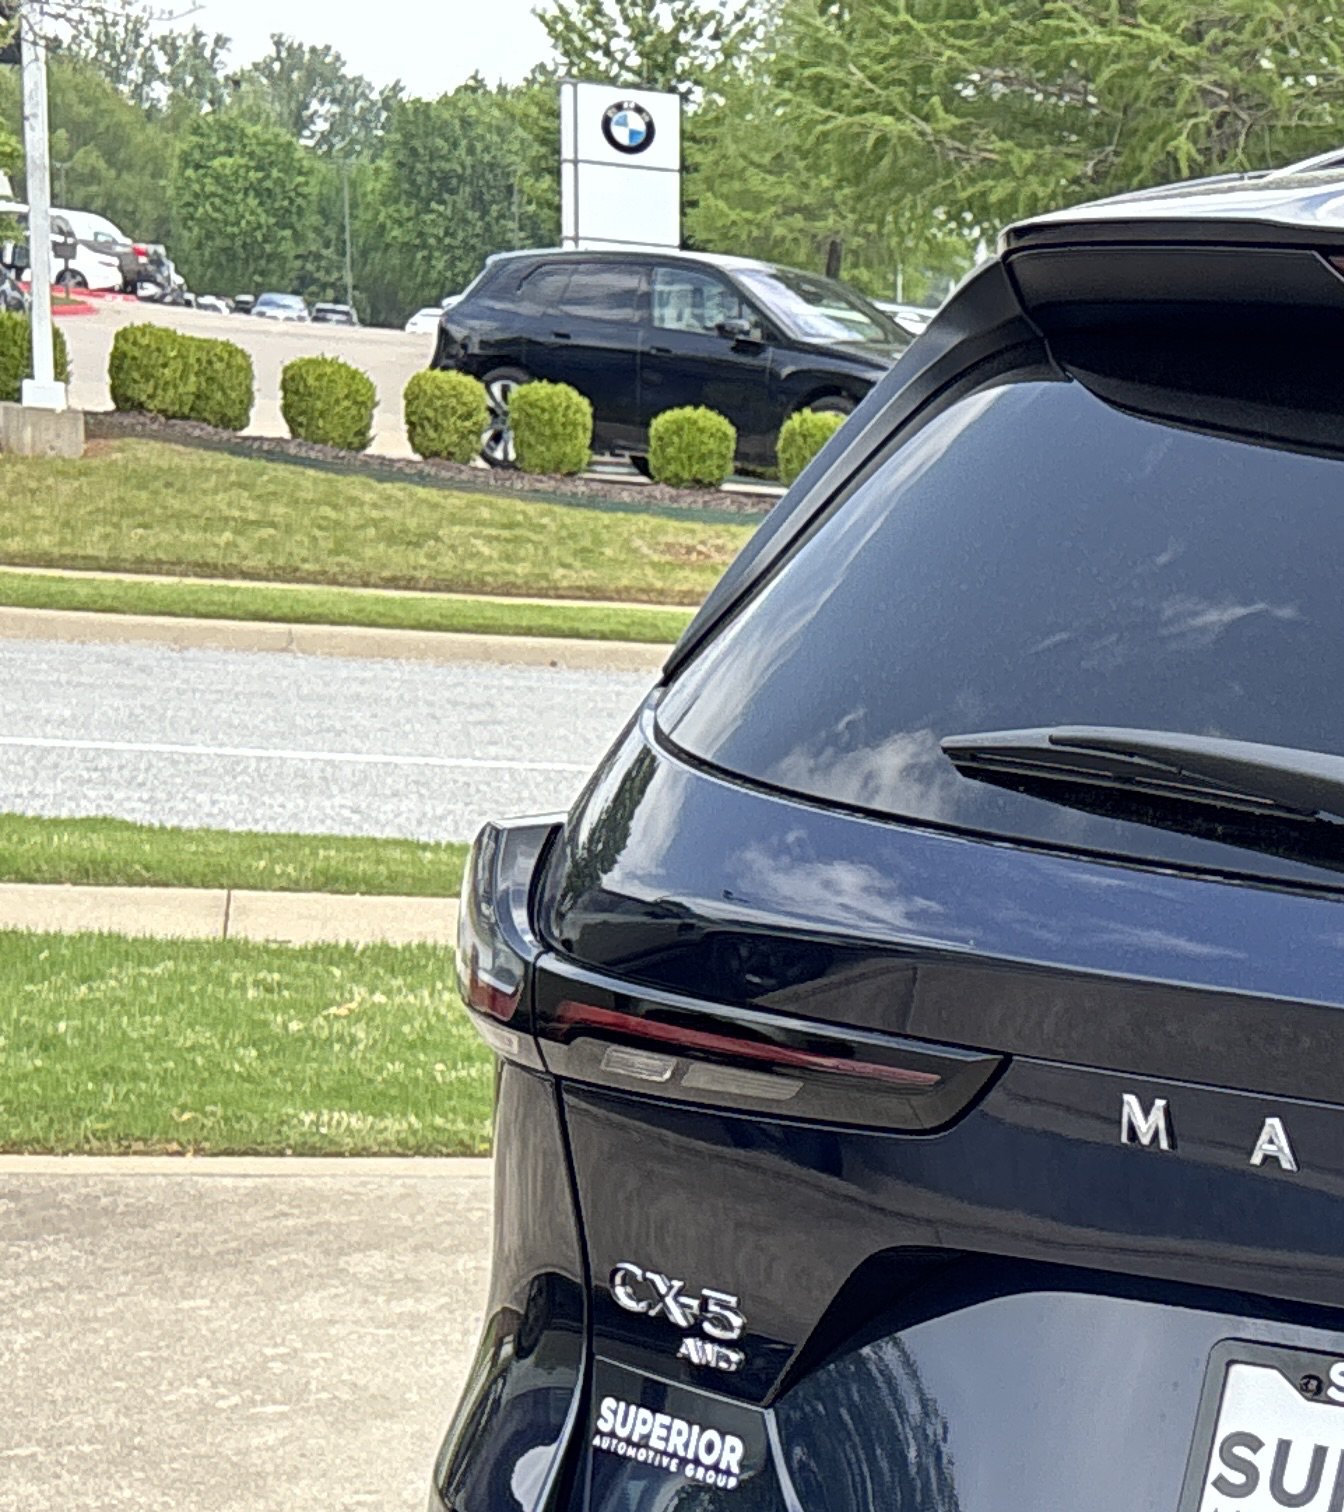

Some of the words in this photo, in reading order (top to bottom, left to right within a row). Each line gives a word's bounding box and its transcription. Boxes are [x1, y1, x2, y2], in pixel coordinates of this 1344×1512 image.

[609, 1261, 747, 1340] CX-5
[592, 1434, 679, 1473] AUTOMOTIVE
[684, 1462, 738, 1490] GROUP
[597, 1396, 744, 1474] SUPERIOR
